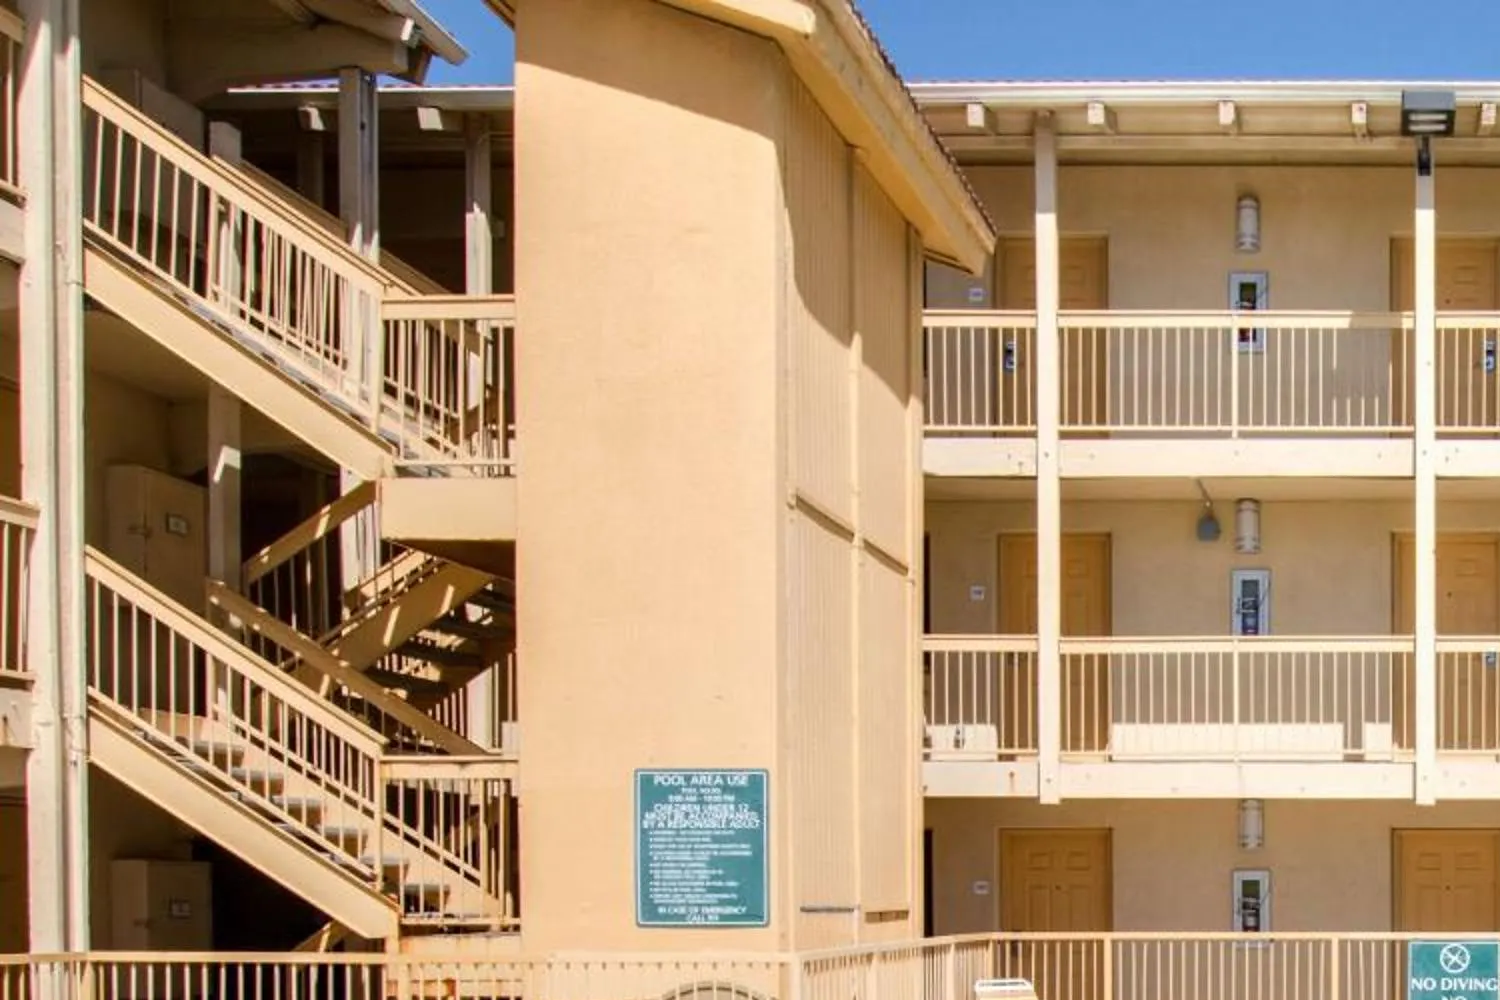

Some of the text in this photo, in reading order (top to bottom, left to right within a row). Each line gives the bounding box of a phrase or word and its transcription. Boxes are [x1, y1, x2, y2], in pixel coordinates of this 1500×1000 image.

[653, 775, 749, 786] POOL AREA USE
[653, 803, 700, 812] CHILDREN
[702, 803, 735, 812] UNDER
[642, 819, 760, 829] BY A RESPONSIBLE ADULT
[1411, 977, 1498, 991] NO DIVING
